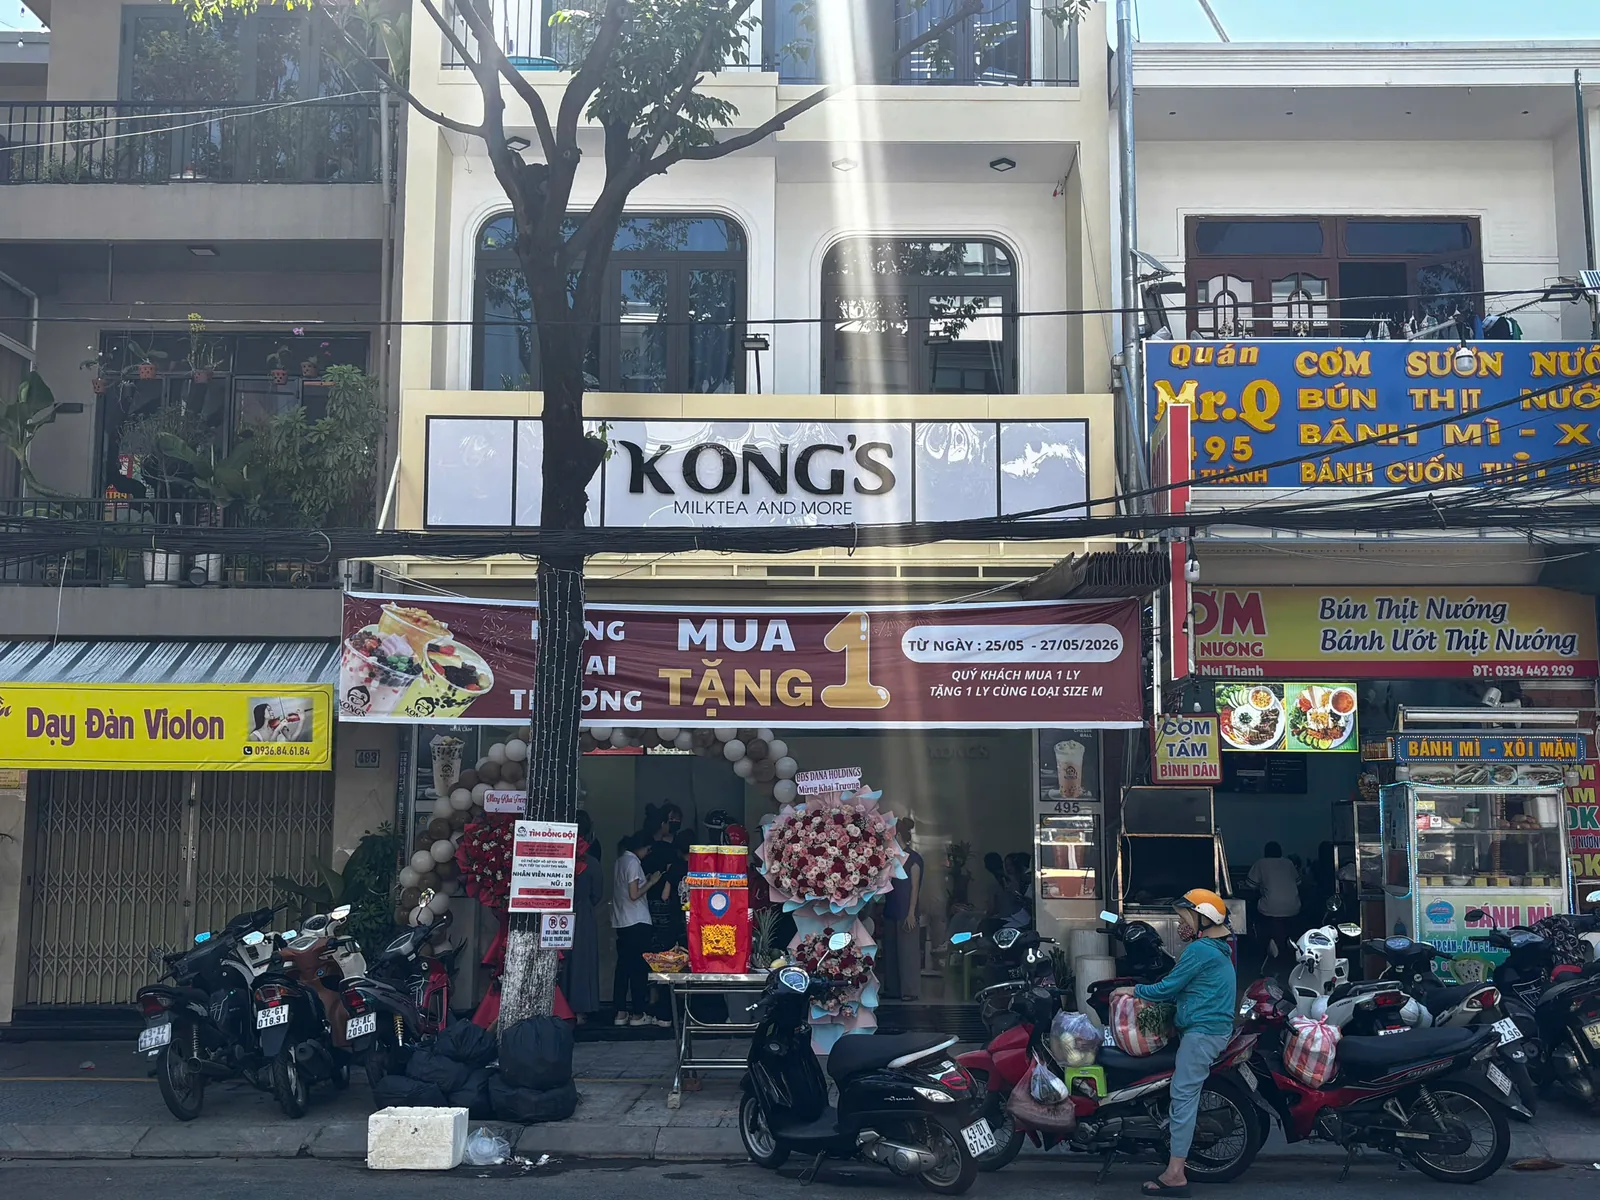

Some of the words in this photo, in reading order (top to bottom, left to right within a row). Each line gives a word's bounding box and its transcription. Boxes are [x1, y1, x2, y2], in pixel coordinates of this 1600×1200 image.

[1170, 343, 1260, 368] Quán
[1295, 346, 1371, 377] CƠM
[1154, 379, 1280, 432] Mr.Q
[1298, 382, 1377, 410] BÚN
[1409, 389, 1482, 414] THỊT
[1300, 419, 1418, 446] BÁNH
[1444, 417, 1500, 446] MÌ
[619, 434, 896, 495] KONG'S
[1301, 457, 1374, 484] BÁNH
[1386, 453, 1464, 483] CUỐN
[674, 500, 747, 515] MILKTEA
[757, 500, 796, 515] AND
[801, 500, 852, 515] MORE
[1194, 591, 1266, 635] ƠM
[1320, 598, 1368, 620] Bún
[1375, 597, 1418, 623] Thịt
[1426, 597, 1508, 623] Nướng
[678, 618, 796, 652] MUA
[1321, 629, 1384, 651] Bánh
[1392, 629, 1437, 650] Ướt
[1445, 629, 1488, 655] Thịt
[1496, 629, 1577, 655] Nướng
[908, 638, 929, 651] TỪ
[934, 638, 974, 651] NGÀY
[986, 639, 1024, 651] 25/05
[1040, 639, 1118, 651] 27/05/2026
[952, 668, 977, 680] QUÝ
[980, 668, 1021, 680] KHÁCH
[1025, 670, 1052, 680] MUA
[1056, 670, 1062, 680] 1
[1067, 670, 1080, 680] LY
[1202, 665, 1222, 676] Núi
[1472, 665, 1493, 676] ĐT:
[1495, 665, 1523, 676] 0334
[1526, 665, 1549, 676] 442
[1552, 665, 1574, 676] 229
[658, 658, 814, 716] TẶNG
[930, 684, 962, 698] TẶNG
[966, 686, 971, 696] 1
[976, 686, 990, 696] LY
[993, 684, 1028, 697] CÙNG
[1031, 686, 1059, 698] LOẠI
[1063, 686, 1088, 696] SIZE
[1092, 686, 1103, 696] M
[26, 707, 76, 746] Dạy
[85, 708, 134, 740] Đàn
[144, 707, 224, 740] Violon
[1163, 719, 1210, 735] CƠM
[254, 746, 310, 756] 0936.84.61.84
[1166, 737, 1207, 757] TẤM
[1409, 738, 1453, 757] BÁNH
[1459, 738, 1481, 757] MÌ
[1503, 738, 1534, 757] XÔI
[1540, 738, 1577, 760] MẶN
[810, 771, 828, 781] DANA
[828, 767, 861, 779] HOLDINGS
[1160, 762, 1189, 777] BÌNH
[1193, 763, 1217, 777] DÂN
[819, 784, 834, 792] Khai
[1054, 801, 1080, 813] 495
[258, 1014, 286, 1028] 018.91
[261, 1007, 284, 1019] 92-G1
[350, 1014, 371, 1028] 43-AC
[347, 1022, 374, 1038] 209.00
[966, 1122, 987, 1140] 43-D1
[969, 1133, 994, 1155] 974.19
